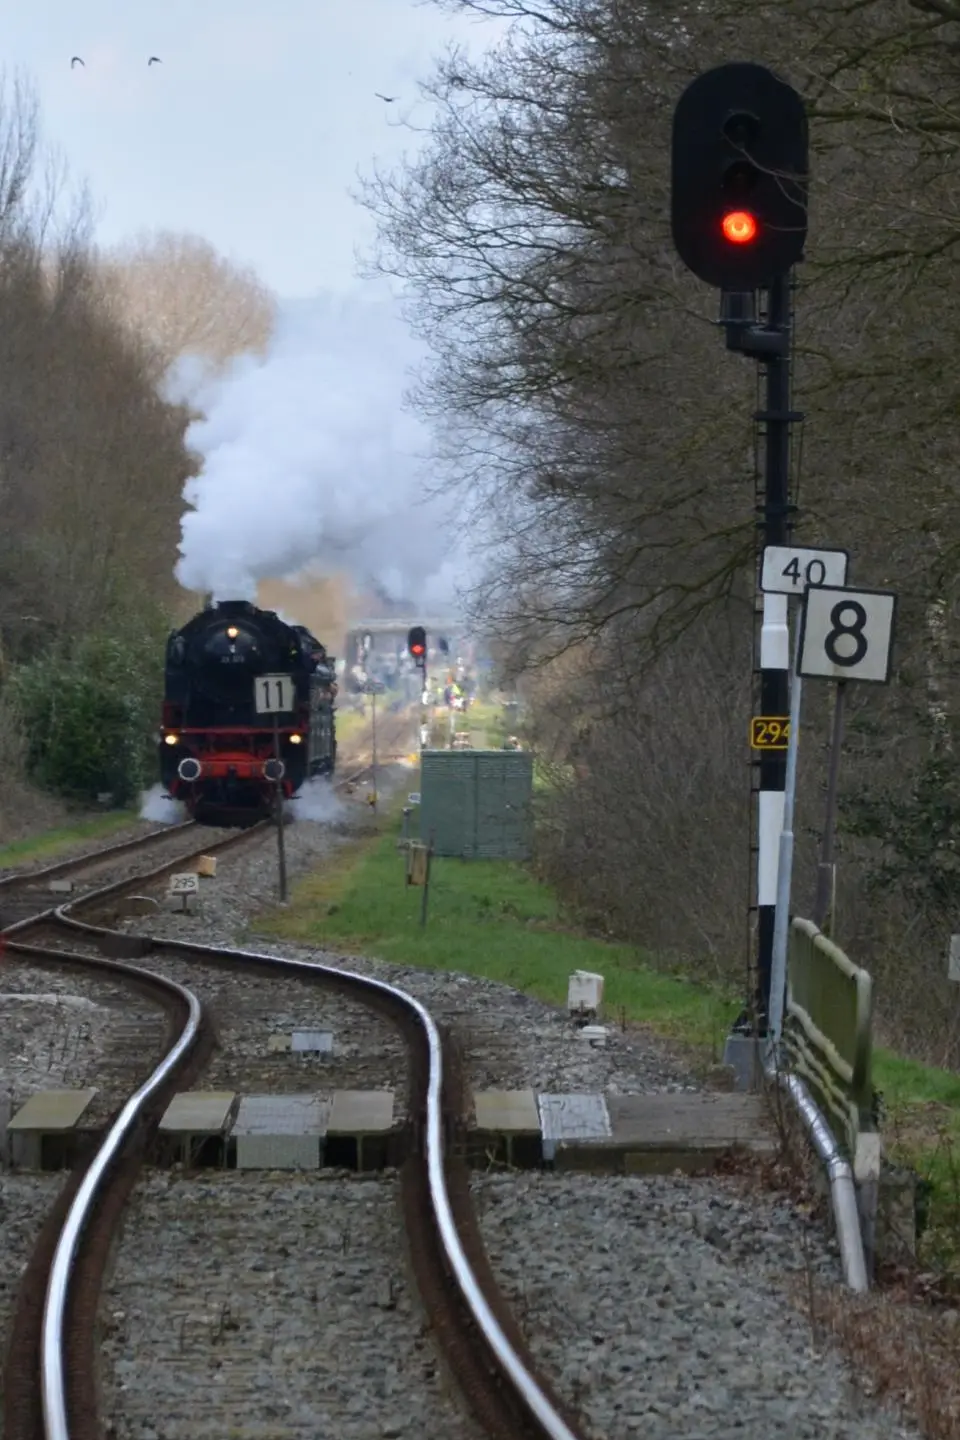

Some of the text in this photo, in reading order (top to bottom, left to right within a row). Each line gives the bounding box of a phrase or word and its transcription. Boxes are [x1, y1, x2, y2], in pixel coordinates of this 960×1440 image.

[782, 557, 826, 585] 40
[824, 600, 868, 667] 8
[263, 680, 285, 709] 11
[174, 877, 196, 889] 295
